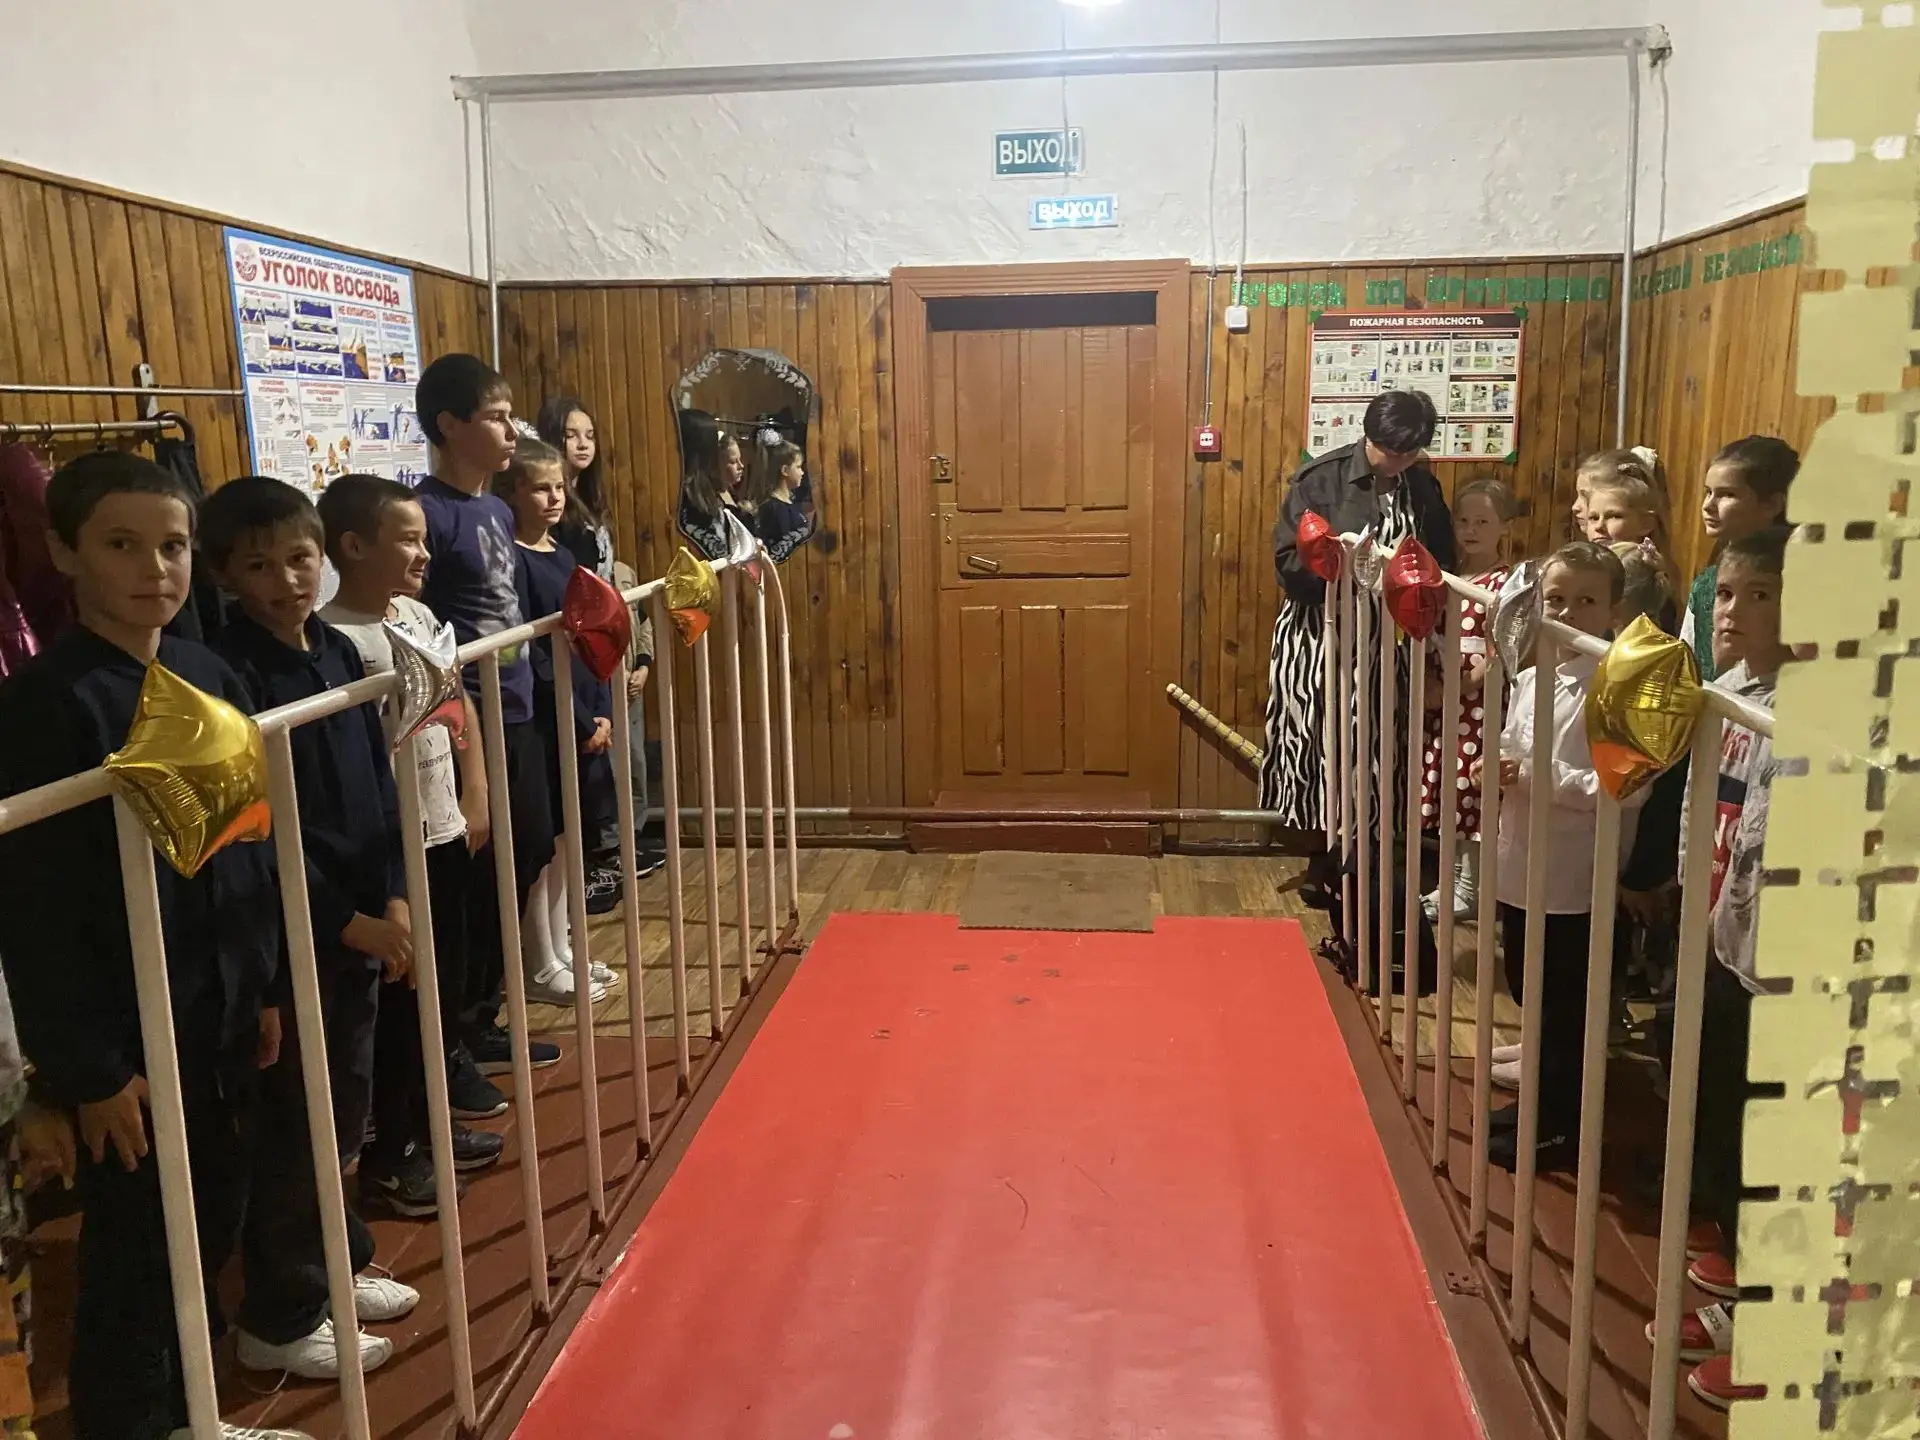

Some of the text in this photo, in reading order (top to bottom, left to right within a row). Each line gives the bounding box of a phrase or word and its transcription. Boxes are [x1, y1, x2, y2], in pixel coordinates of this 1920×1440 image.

[1038, 200, 1109, 220] ВЫХОД
[260, 258, 401, 308] УГОЛОК ВОСВОДа
[1349, 317, 1484, 327] ПОЖАРНАЯ БЕЗОПАСНОСТЬ
